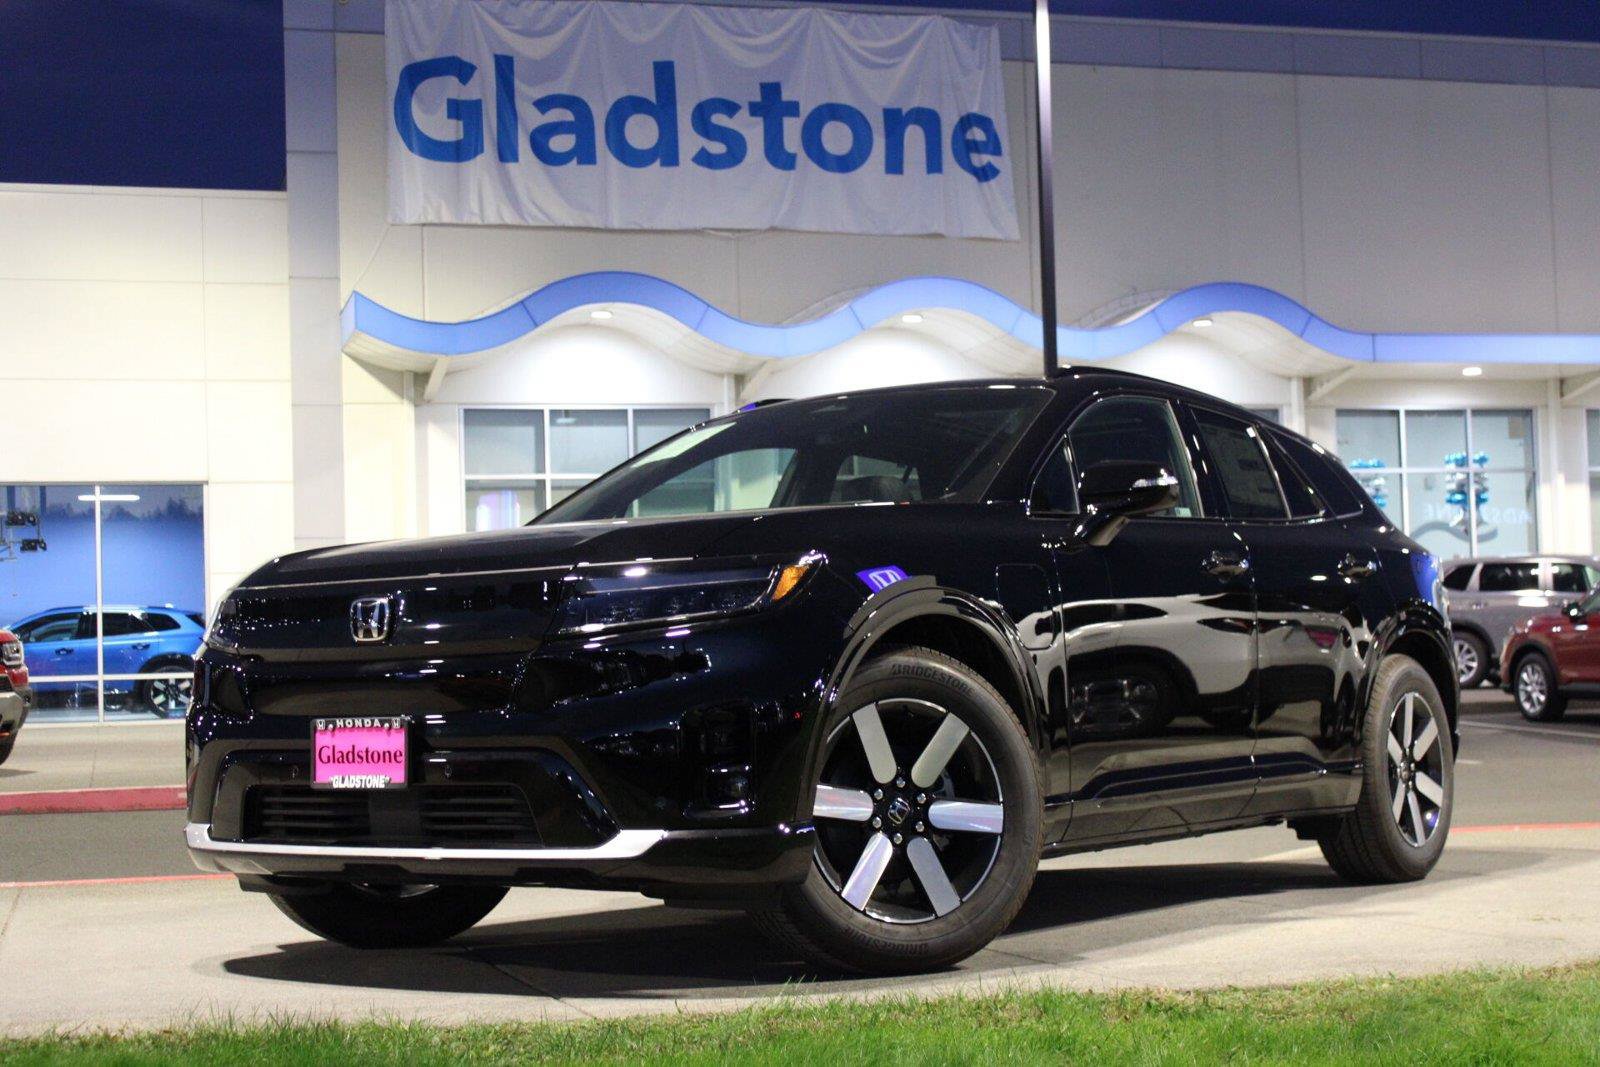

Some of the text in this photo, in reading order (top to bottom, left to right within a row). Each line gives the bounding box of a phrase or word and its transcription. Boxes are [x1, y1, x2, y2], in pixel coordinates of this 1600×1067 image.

[394, 53, 1003, 183] Gladstone
[336, 718, 382, 728] HONDA
[318, 744, 403, 764] Gladstone
